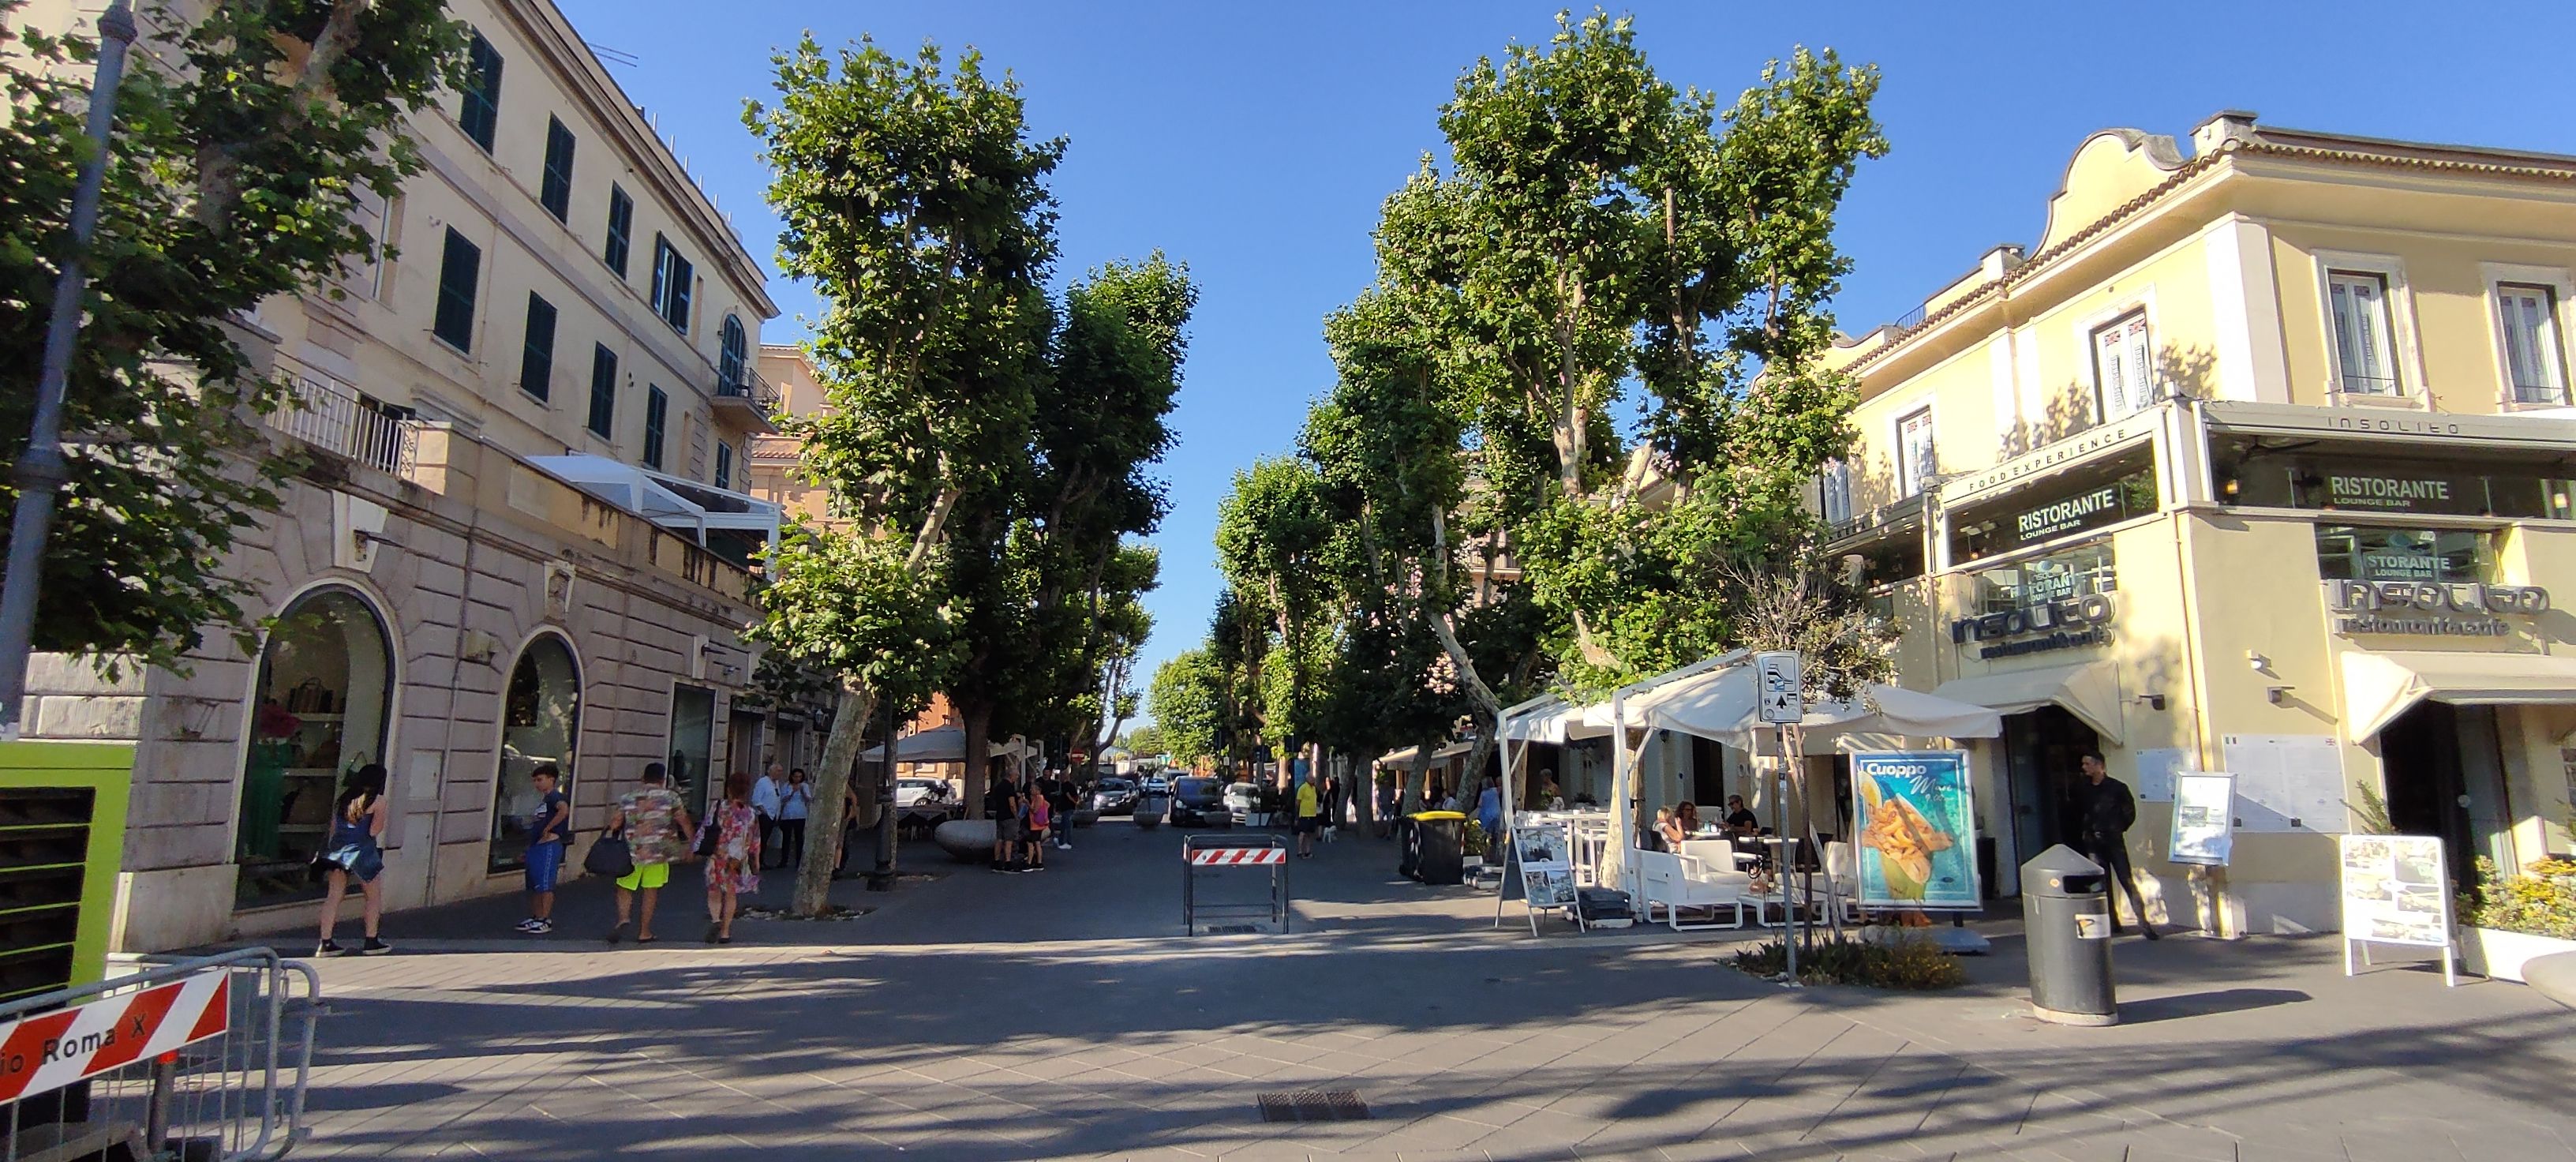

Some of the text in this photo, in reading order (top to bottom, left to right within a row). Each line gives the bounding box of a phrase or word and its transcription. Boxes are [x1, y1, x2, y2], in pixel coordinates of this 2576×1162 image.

[2328, 417, 2459, 434] INSOLITO
[1969, 429, 2125, 492] FOOD EXPERIENCE
[2331, 476, 2450, 500] RISTORANTE
[2018, 488, 2115, 533] RISTORANTE
[2334, 497, 2383, 506] LOUNGE
[2020, 519, 2081, 541] LOUNGE BAR
[2368, 555, 2451, 570] STORANTE
[2375, 568, 2412, 577] LOUNGE
[1866, 763, 1927, 778] Cuoppo
[42, 1028, 116, 1065] Roma
[131, 1013, 148, 1038] X
